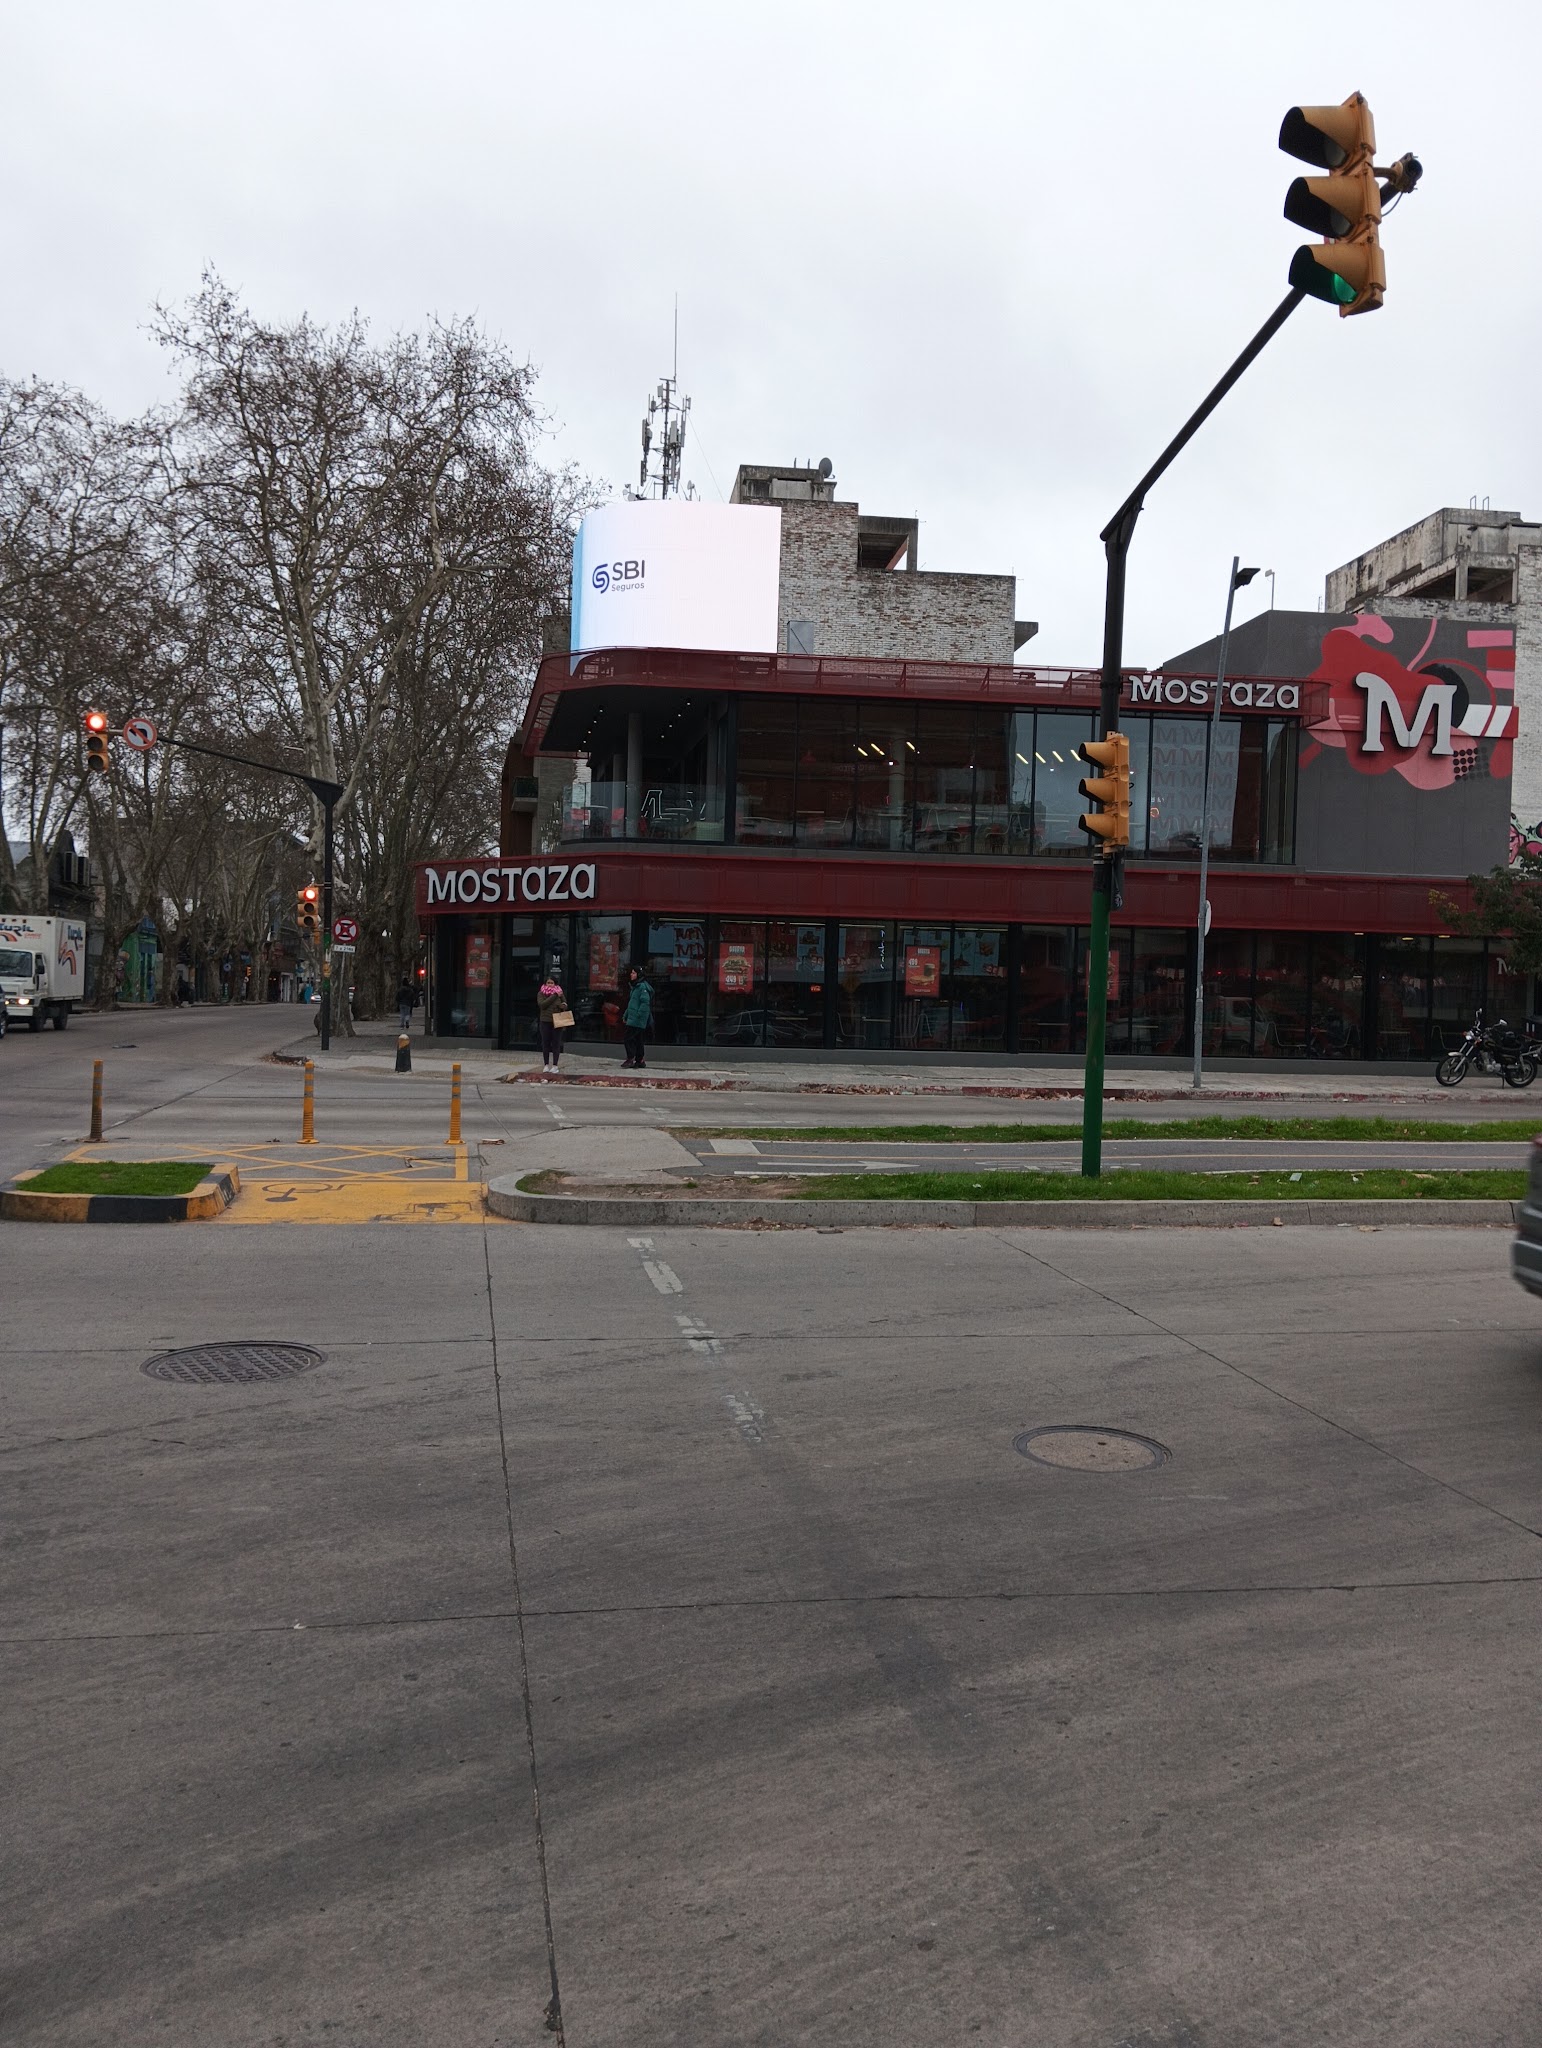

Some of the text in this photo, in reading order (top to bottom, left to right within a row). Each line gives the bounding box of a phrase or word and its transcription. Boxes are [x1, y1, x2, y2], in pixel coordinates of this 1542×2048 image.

[612, 559, 645, 581] SBI
[611, 582, 645, 592] Seguros
[1355, 671, 1458, 755] M
